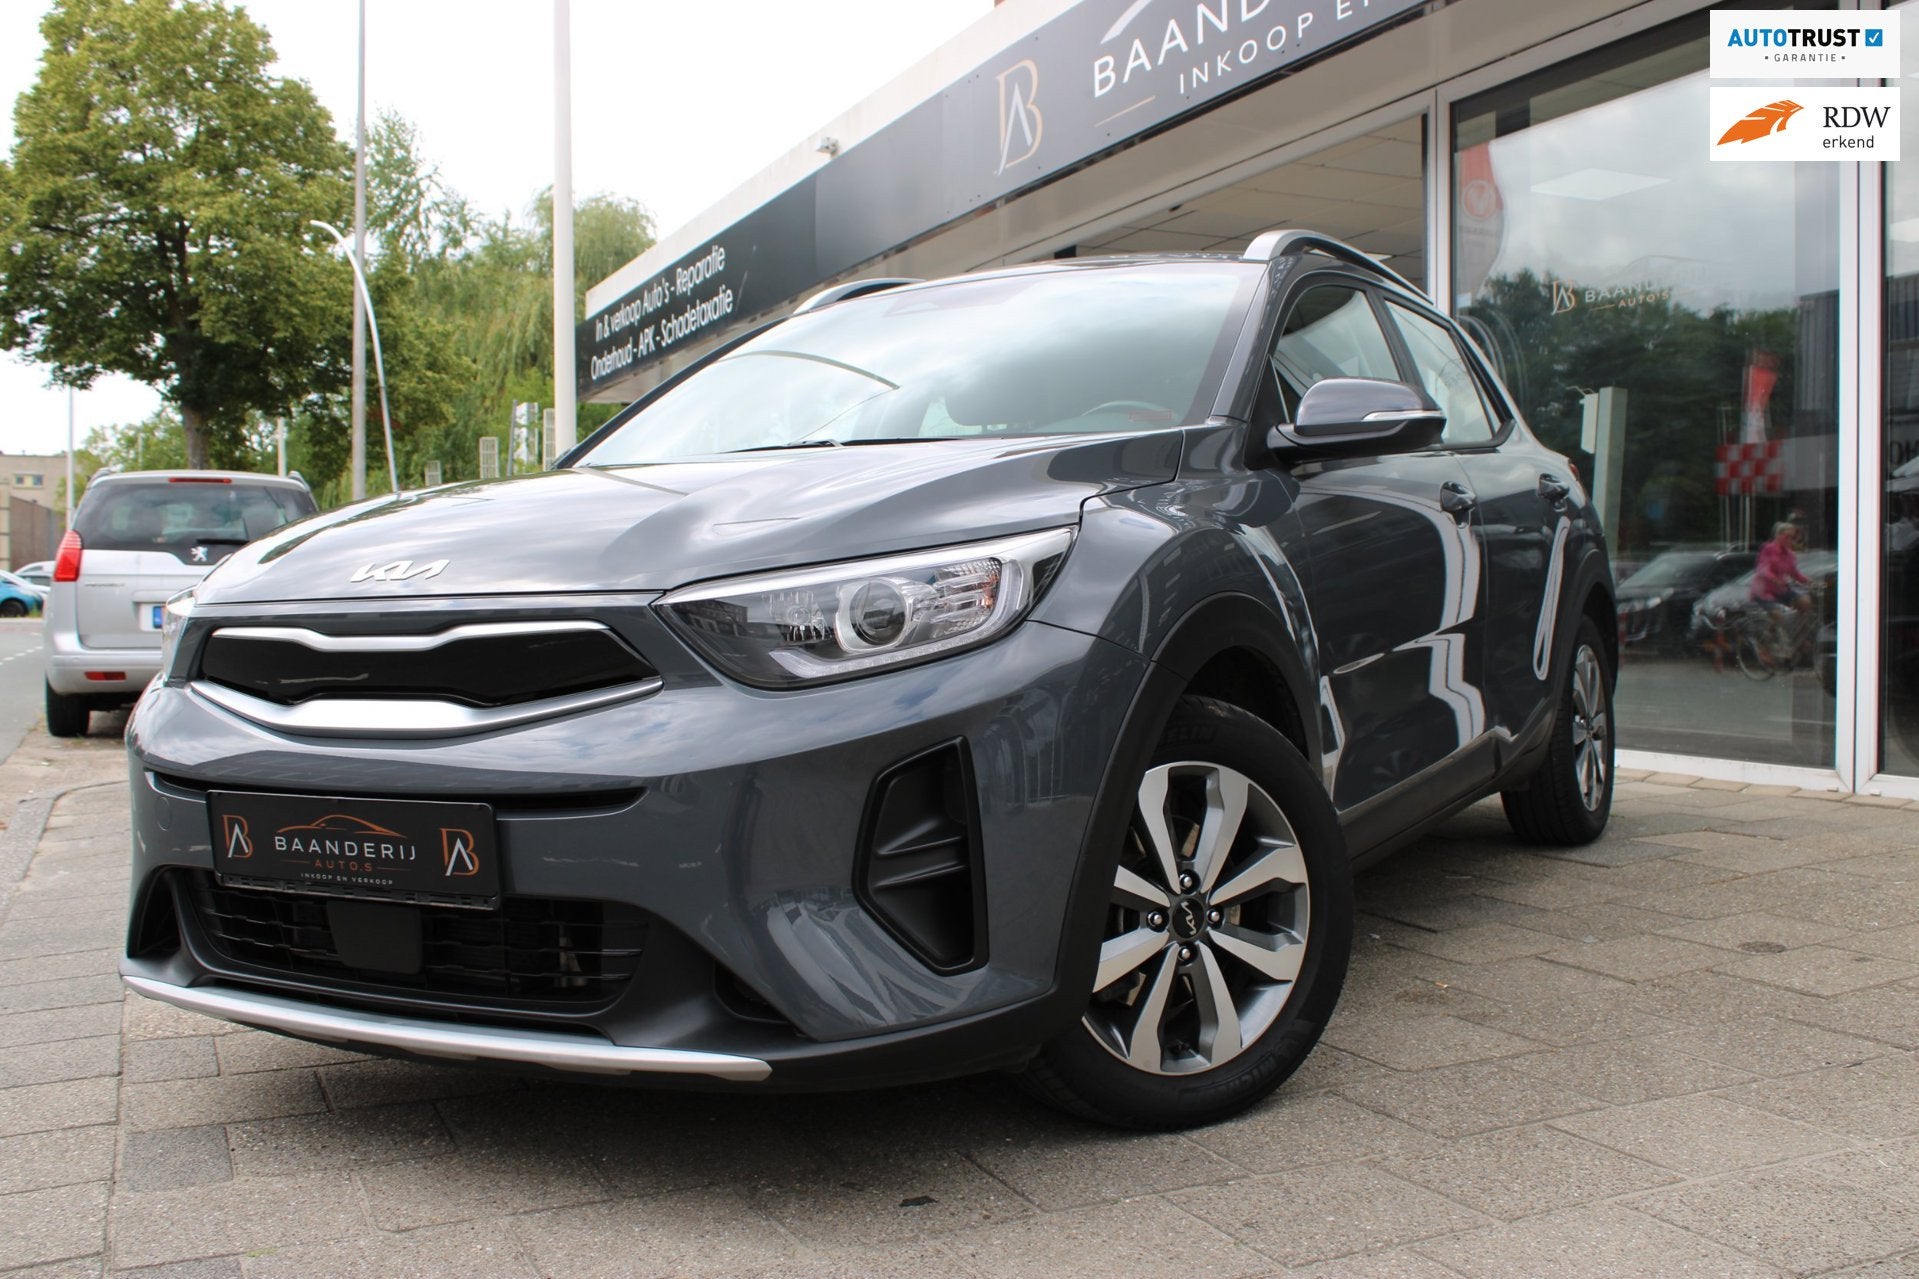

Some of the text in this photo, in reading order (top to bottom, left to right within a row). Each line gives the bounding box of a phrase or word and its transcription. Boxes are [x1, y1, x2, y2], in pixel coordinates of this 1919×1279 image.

[1180, 0, 1370, 94] INKOOP E
[590, 336, 633, 380] Onderhoud
[638, 324, 656, 358] APK
[660, 284, 733, 347] Schadetaxatie
[595, 319, 603, 342] In
[610, 299, 642, 333] verkoop
[642, 277, 670, 316] Auto's
[676, 244, 726, 296] Reparatie
[275, 836, 416, 860] BAANDERIJ
[352, 876, 393, 885] VERKOOP
